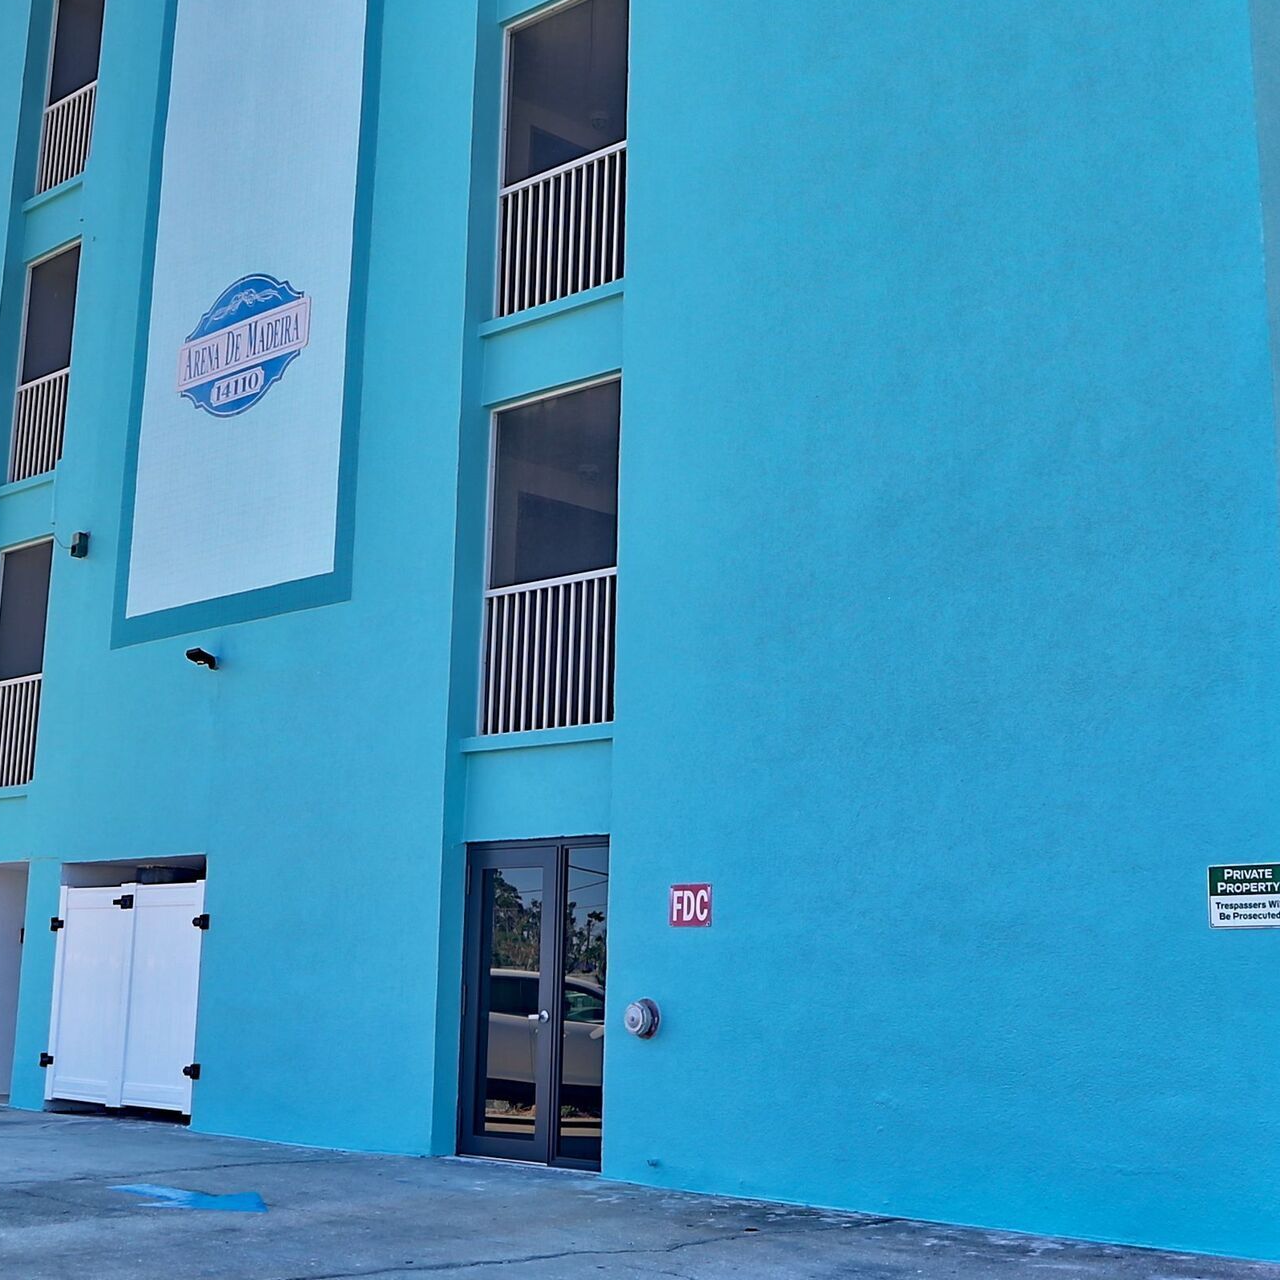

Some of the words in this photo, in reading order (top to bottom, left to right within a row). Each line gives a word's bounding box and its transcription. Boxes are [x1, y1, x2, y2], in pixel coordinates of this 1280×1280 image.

[183, 344, 220, 382] ARENA
[225, 330, 242, 366] DE
[246, 313, 301, 359] MADEIRA
[216, 372, 259, 402] 14110
[1224, 868, 1273, 880] PRIVATE
[1217, 881, 1280, 894] PROPERTY
[673, 889, 708, 921] FDC
[1215, 902, 1266, 911] Trespassers
[1219, 912, 1231, 921] Be
